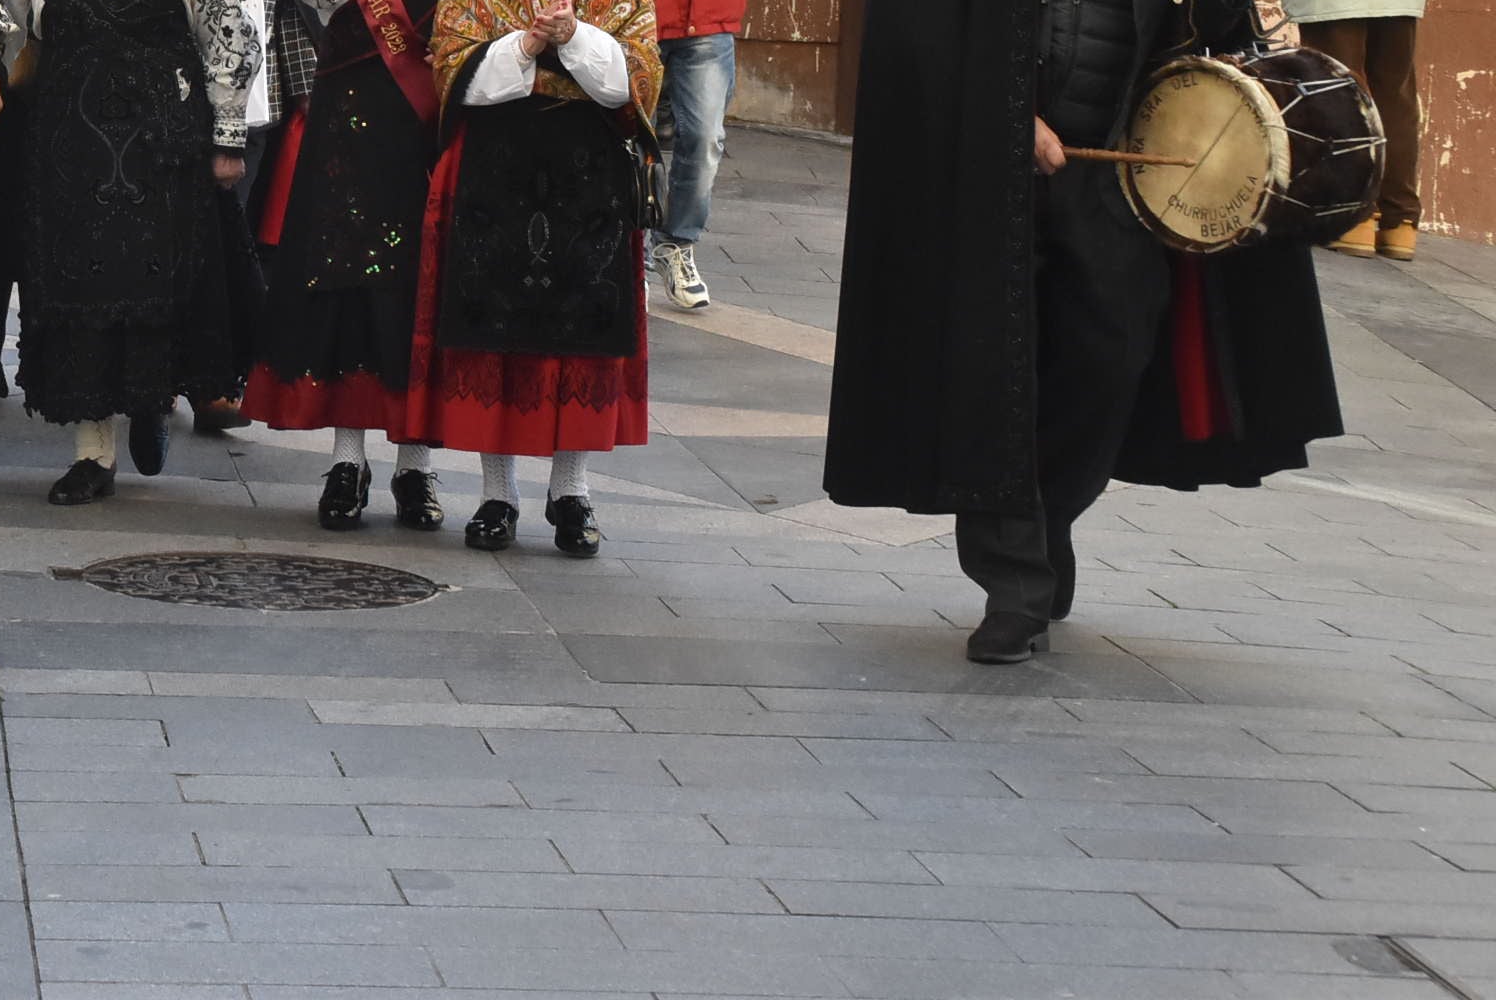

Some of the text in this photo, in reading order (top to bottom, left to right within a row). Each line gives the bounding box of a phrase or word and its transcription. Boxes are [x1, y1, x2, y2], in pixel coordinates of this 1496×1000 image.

[381, 23, 408, 55] 2023
[1134, 137, 1145, 175] NRA
[1171, 73, 1199, 90] DEL
[1200, 216, 1242, 238] BEJAR
